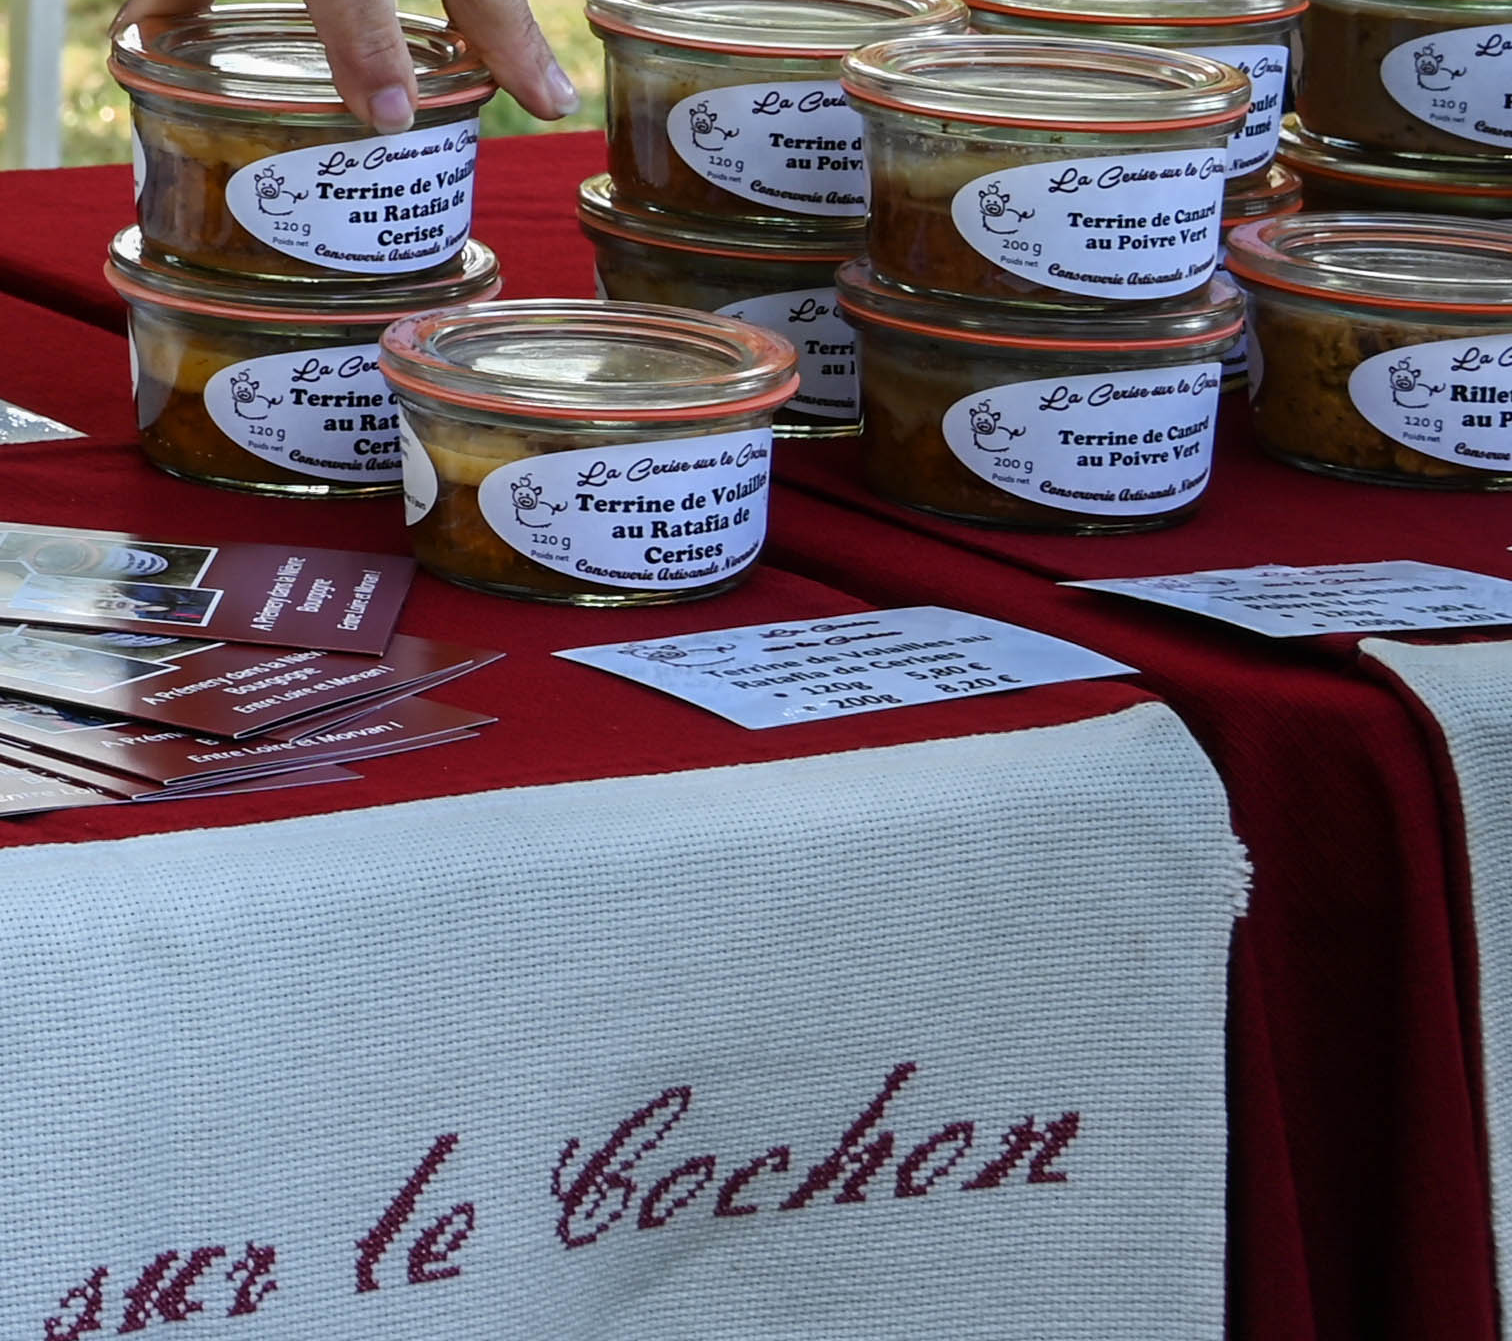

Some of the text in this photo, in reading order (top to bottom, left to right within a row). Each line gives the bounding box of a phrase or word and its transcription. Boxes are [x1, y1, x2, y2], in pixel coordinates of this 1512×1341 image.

[752, 91, 794, 116] La
[769, 133, 847, 151] Terrine
[318, 146, 419, 176] La Cerise
[708, 155, 745, 173] 120 g
[315, 178, 431, 199] Terrine de
[1048, 167, 1093, 194] La
[1097, 165, 1158, 189] Cerise
[349, 190, 464, 223] au Ratafia de
[1067, 200, 1216, 229] Terrine de Canard
[274, 221, 311, 236] 120 g
[377, 223, 444, 246] Cerises
[1085, 227, 1208, 250] au Poivre Vert
[1001, 238, 1042, 256] 200 g
[290, 388, 382, 408] Terrine
[1058, 416, 1210, 446] Terrine de Canard
[1404, 416, 1443, 433] 120 g
[1461, 414, 1492, 428] au
[248, 424, 286, 442] 120 g
[993, 456, 1034, 474] 200 g
[1077, 441, 1200, 467] au Poivre Vert
[577, 461, 622, 488] La
[626, 458, 691, 482] Cerise
[575, 493, 675, 513] Terrine
[681, 492, 706, 510] de
[612, 507, 750, 539] au Ratafia de
[532, 533, 572, 550] 120 g
[644, 543, 723, 565] Cerises
[702, 658, 803, 680] Terrine
[805, 653, 842, 665] de
[838, 637, 954, 659] Volailles
[731, 650, 966, 690] Ratafia de Cerises
[800, 665, 966, 696] 120g 5,80
[828, 679, 997, 709] 200g 8,20
[355, 1131, 476, 1295] le
[549, 1061, 1082, 1251] Cochon
